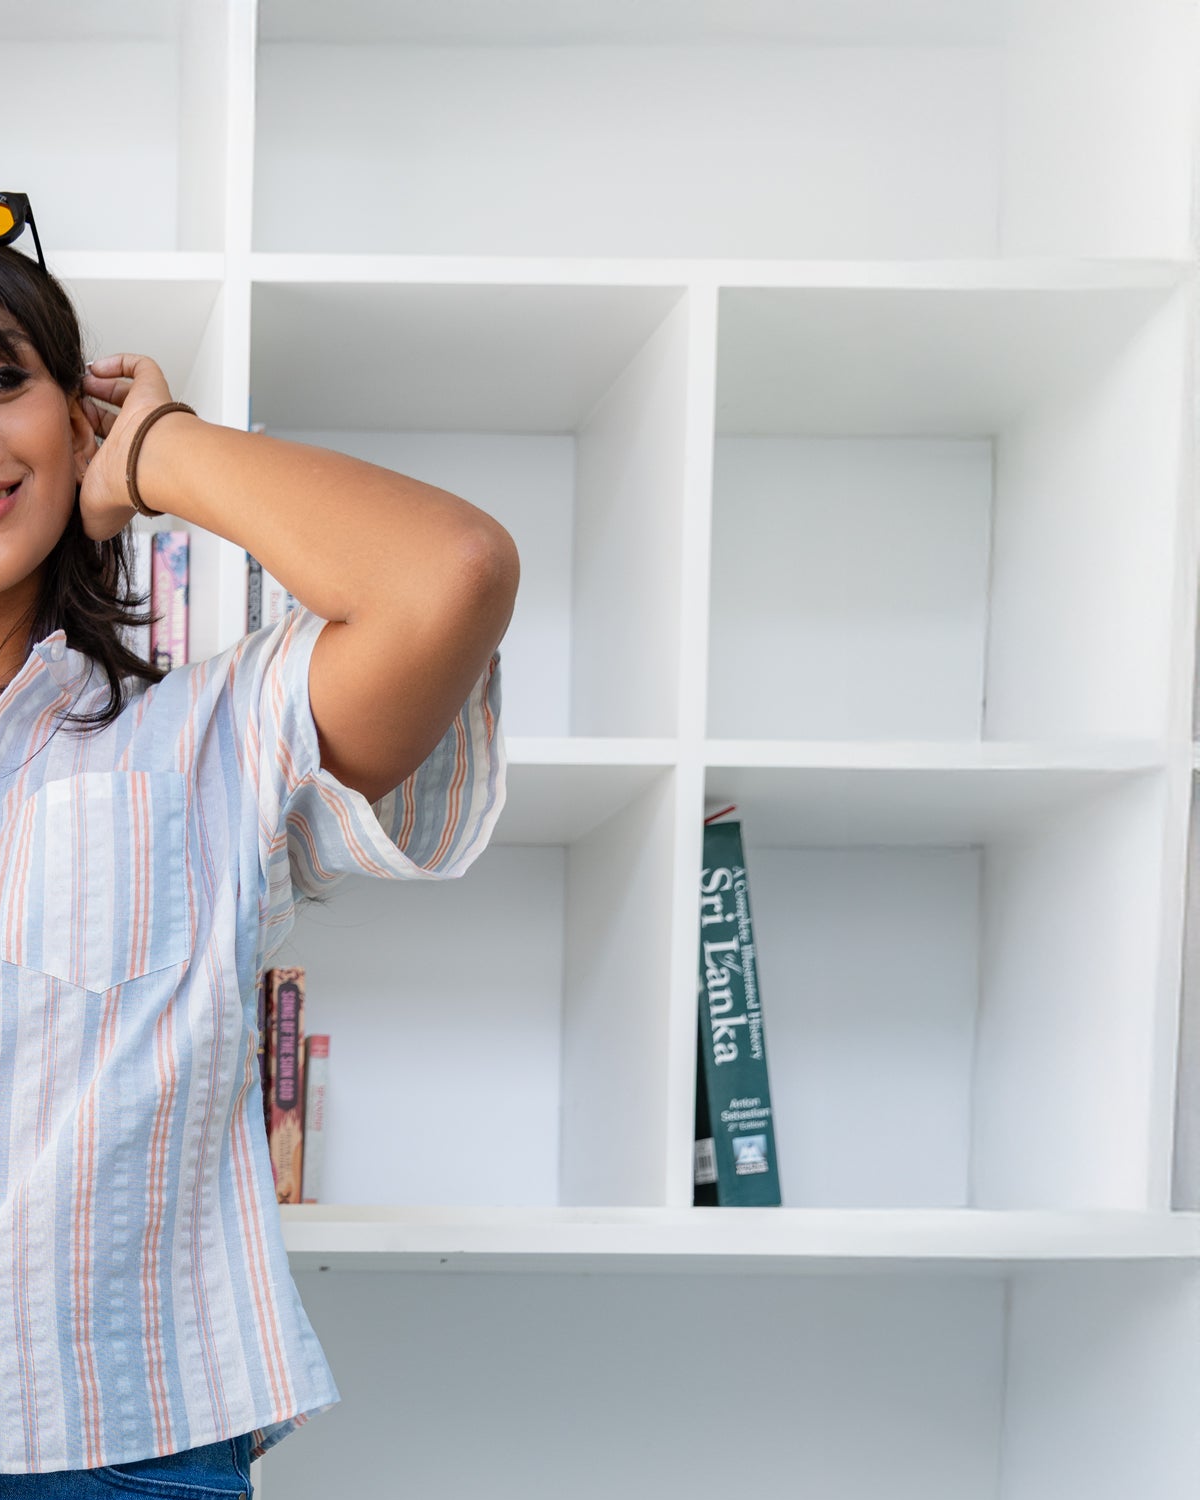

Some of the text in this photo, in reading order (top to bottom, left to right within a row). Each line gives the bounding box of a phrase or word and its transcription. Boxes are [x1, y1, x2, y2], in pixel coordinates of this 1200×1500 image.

[733, 880, 752, 942] Complete
[700, 867, 748, 1066] Sri Lanka
[741, 945, 760, 1009] Illustrated
[747, 1011, 762, 1059] History
[721, 1107, 770, 1122] Sebastian
[730, 1097, 761, 1109] Anton
